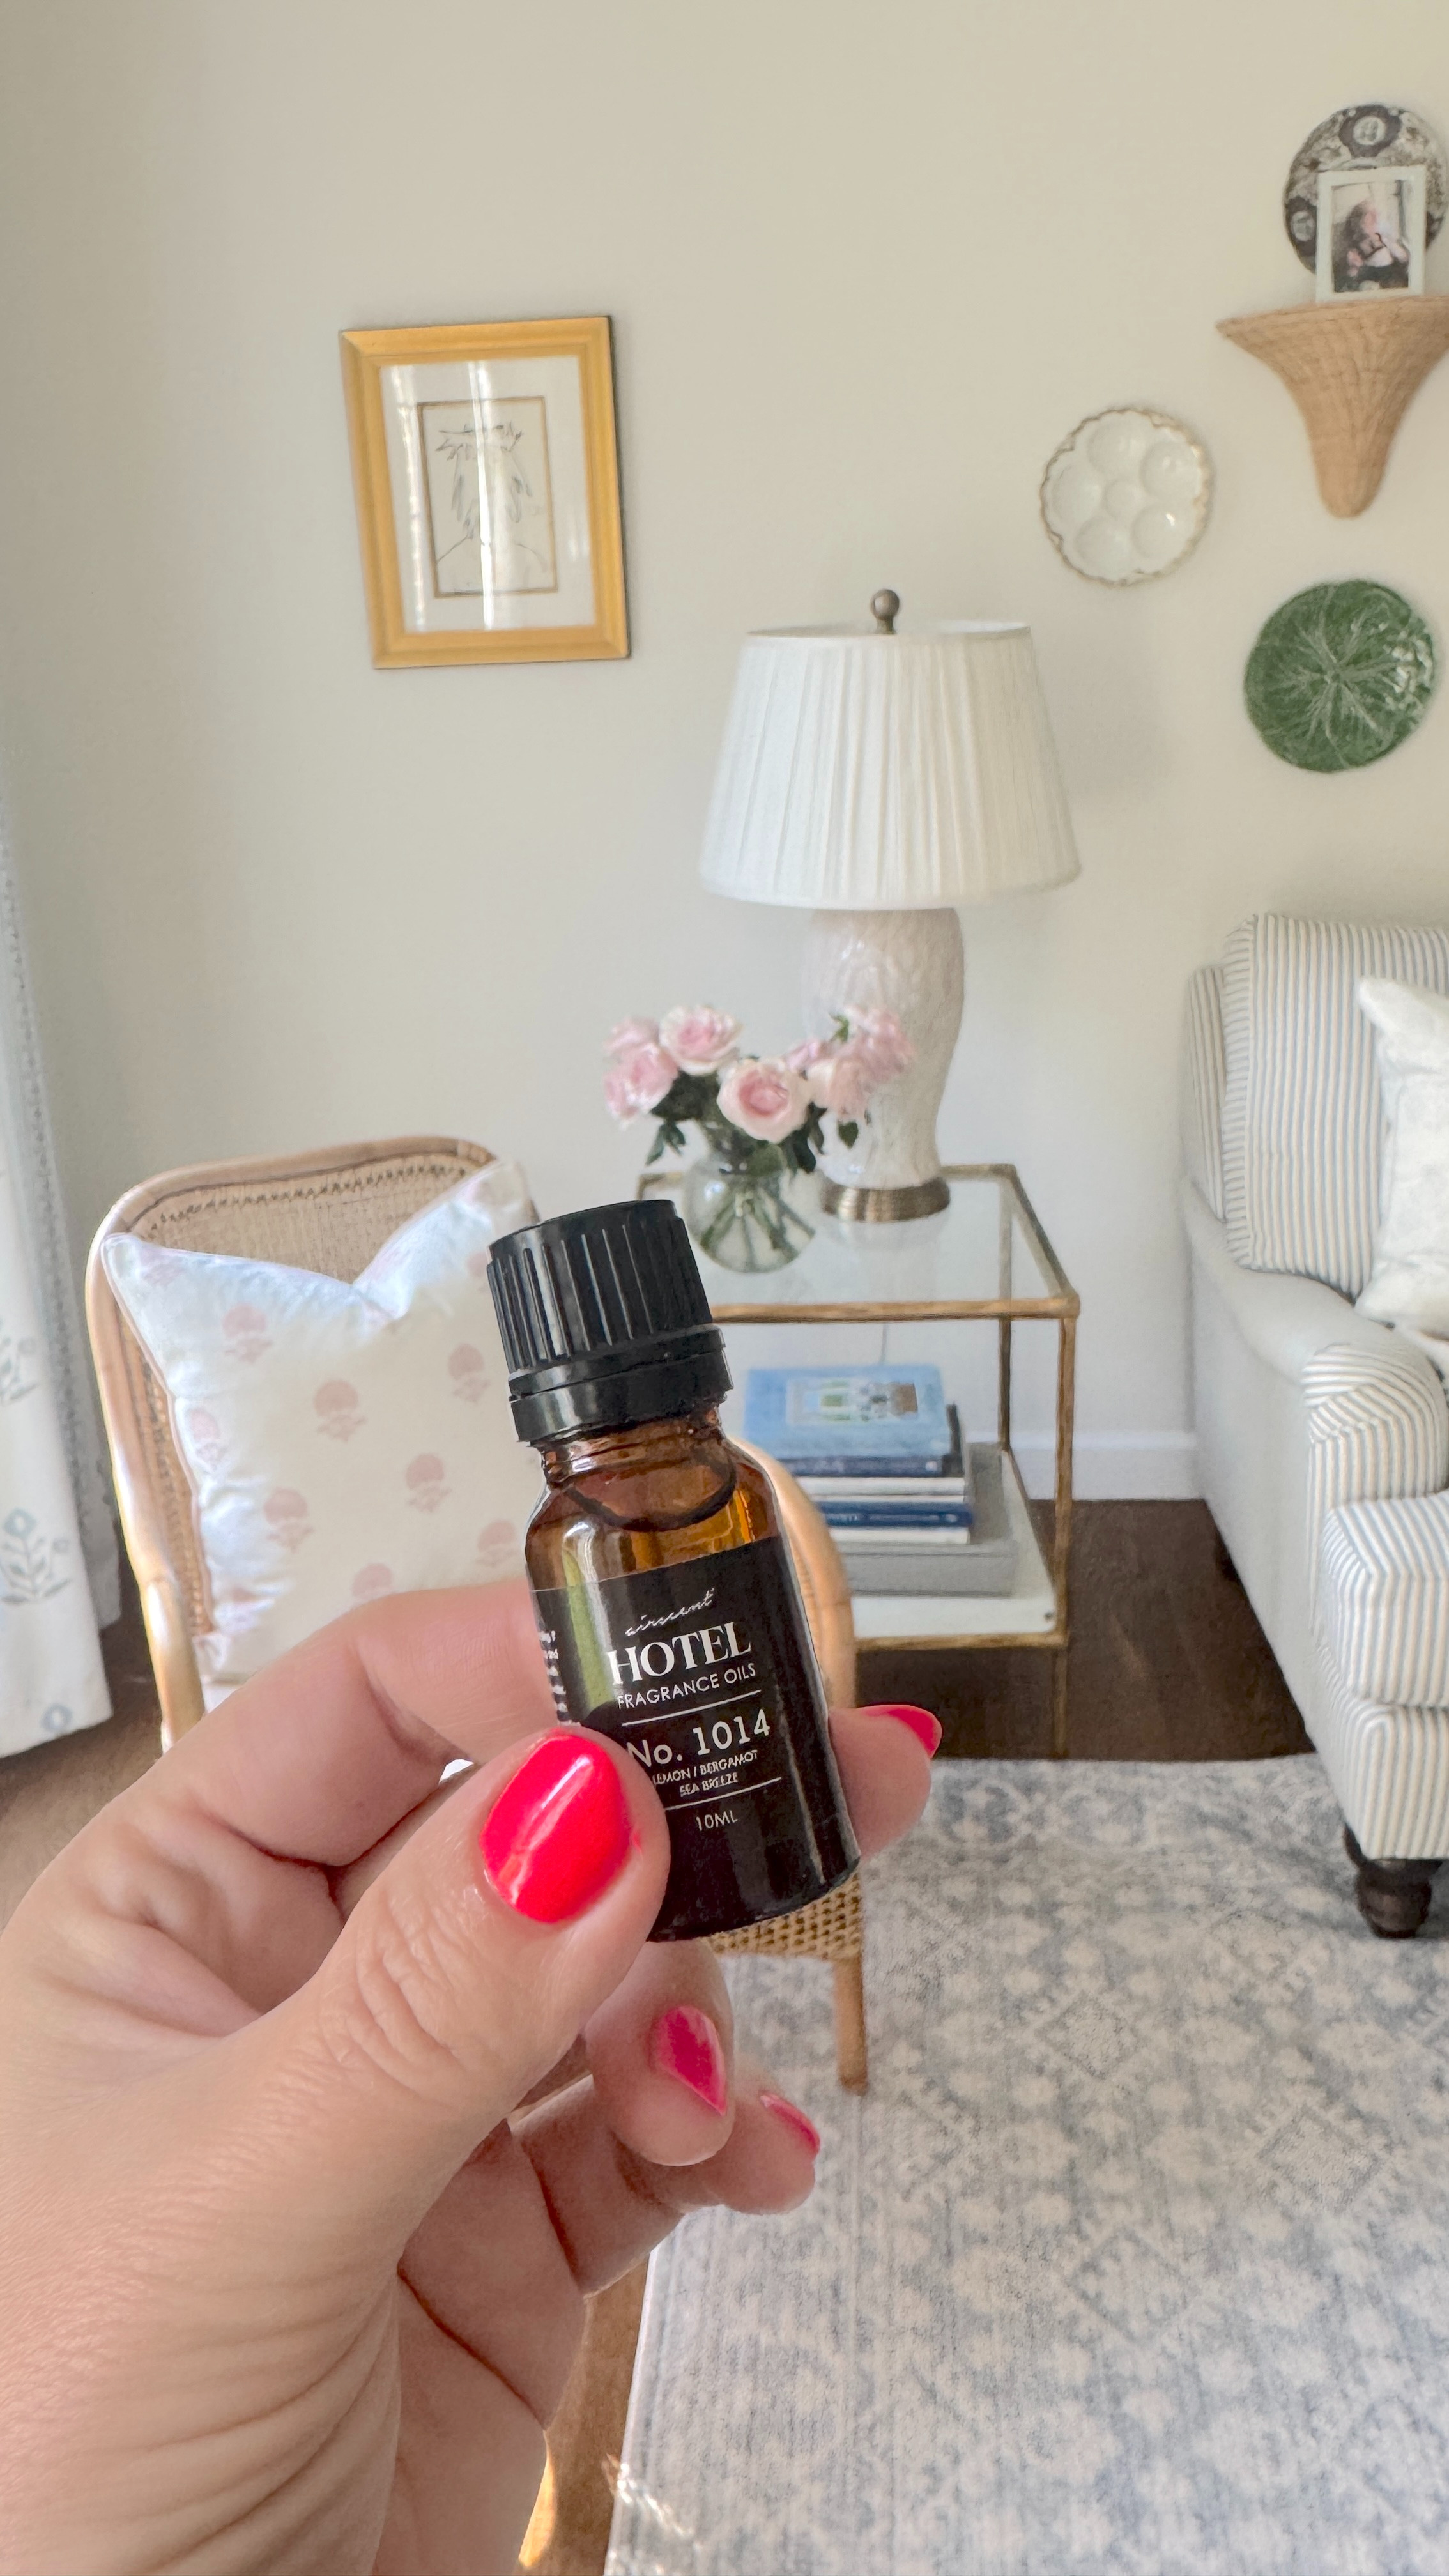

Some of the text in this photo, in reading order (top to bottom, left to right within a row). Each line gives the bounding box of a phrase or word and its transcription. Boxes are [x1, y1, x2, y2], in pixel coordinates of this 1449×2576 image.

[608, 1621, 751, 1685] HOTEL
[618, 1662, 756, 1709] FRAGRANCE OILS
[627, 1708, 770, 1767] No. 1014
[700, 1749, 758, 1775] BERGAMOT
[680, 1772, 739, 1798] SEA BREEZE
[696, 1809, 739, 1831] 10ML
